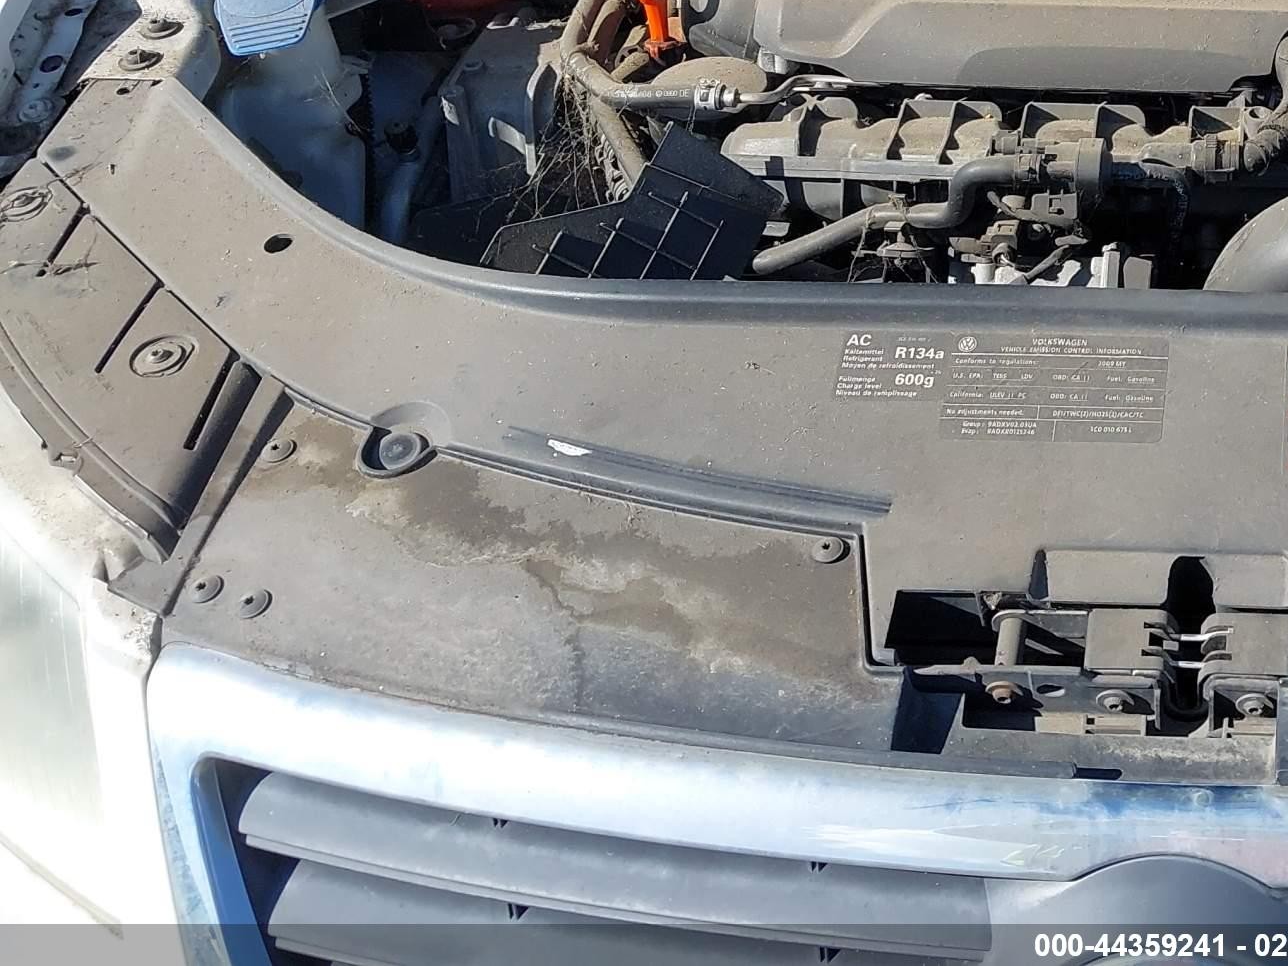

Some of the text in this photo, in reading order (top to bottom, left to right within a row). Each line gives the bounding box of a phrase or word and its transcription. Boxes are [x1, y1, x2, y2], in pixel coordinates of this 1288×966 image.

[846, 334, 872, 346] AC
[1032, 338, 1088, 346] VOLKSWAGEN
[894, 346, 944, 359] R134a
[894, 374, 934, 388] 600g
